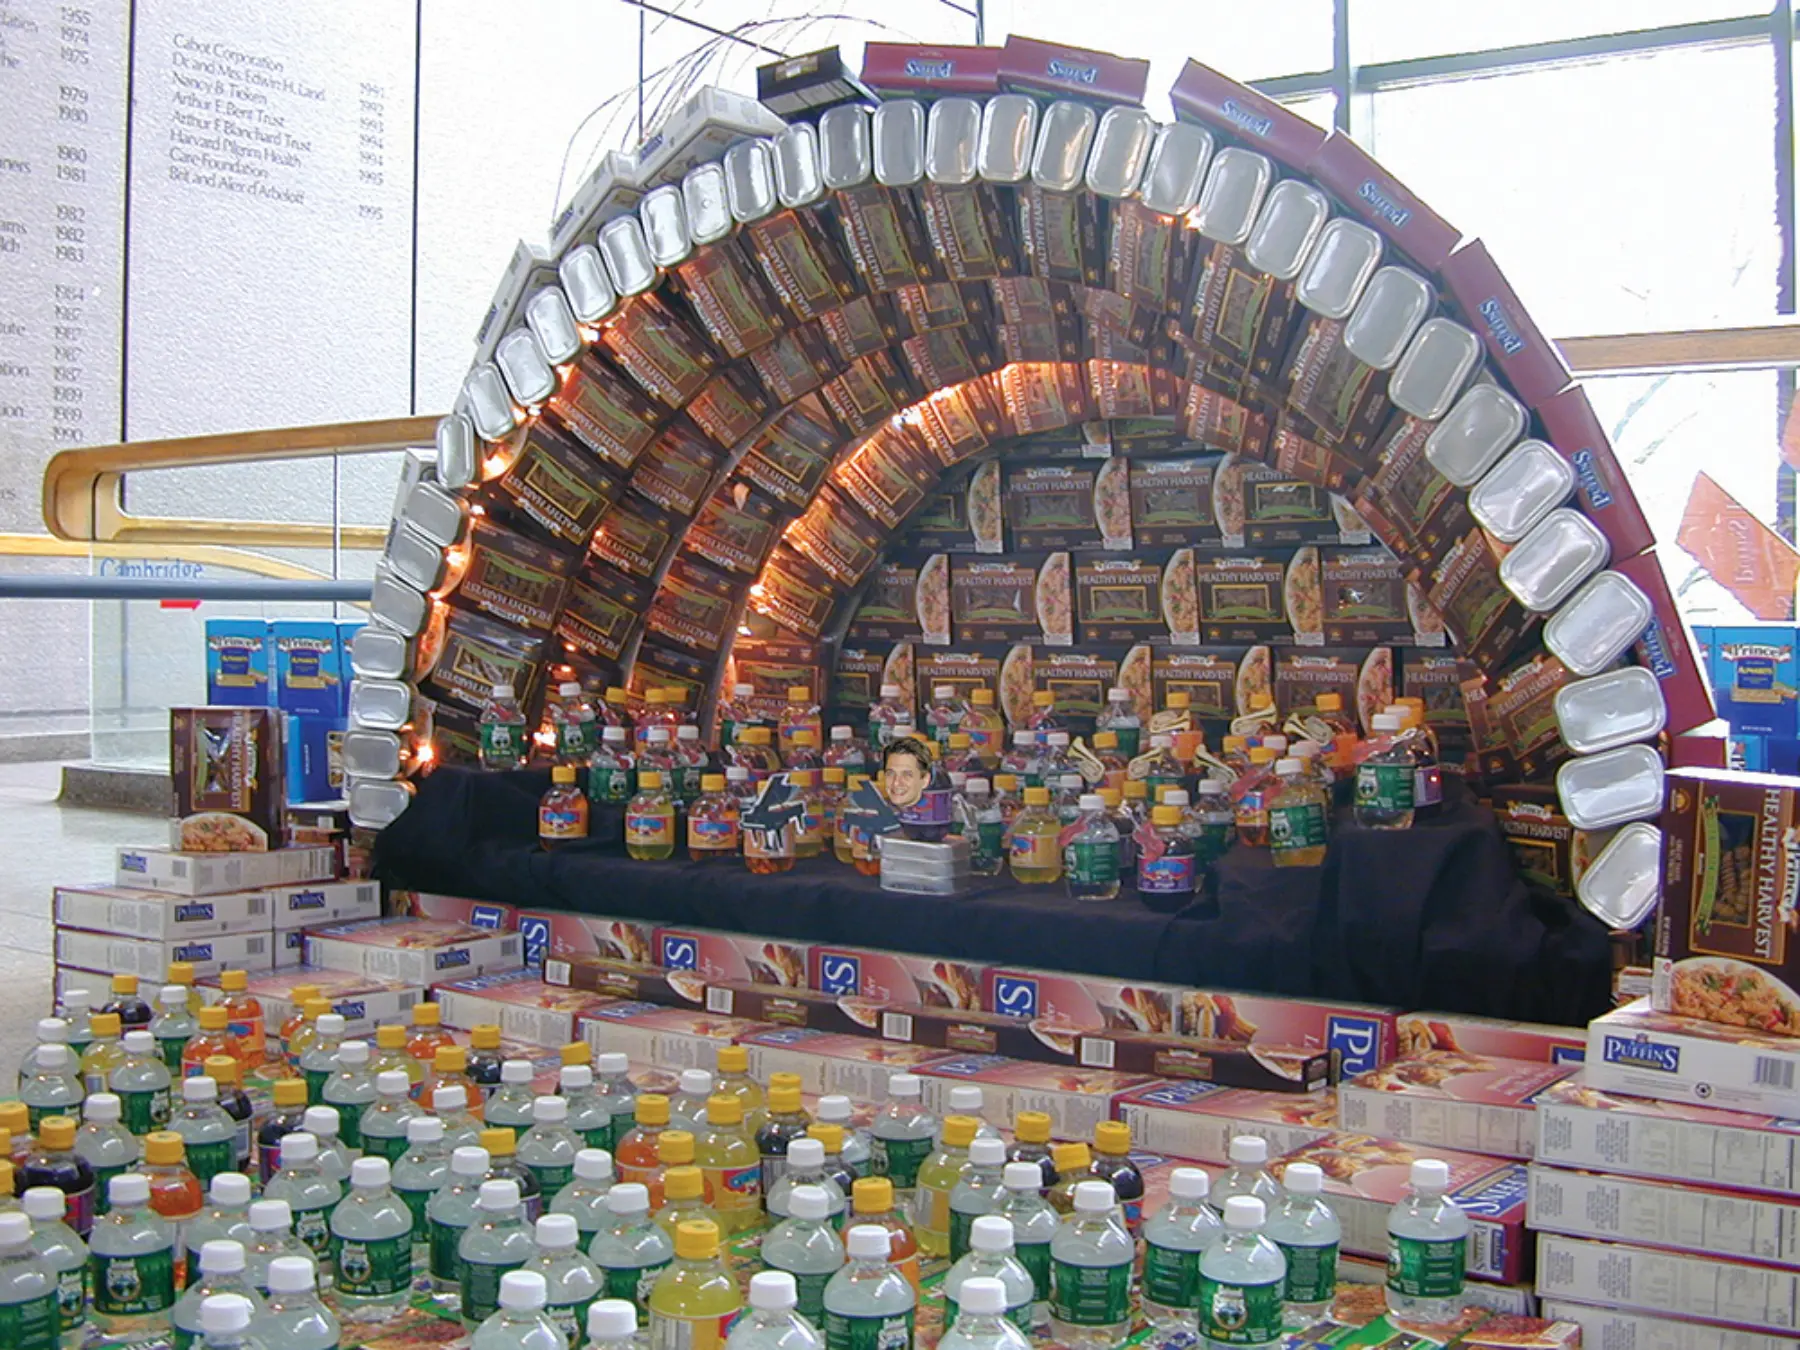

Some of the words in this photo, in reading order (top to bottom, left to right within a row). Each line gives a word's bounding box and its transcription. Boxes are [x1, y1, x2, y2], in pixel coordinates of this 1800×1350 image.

[1733, 644, 1780, 656] Prince
[1759, 788, 1780, 873] HEALTHY
[1752, 877, 1773, 958] HARVEST
[1605, 1037, 1679, 1070] PUFFINS
